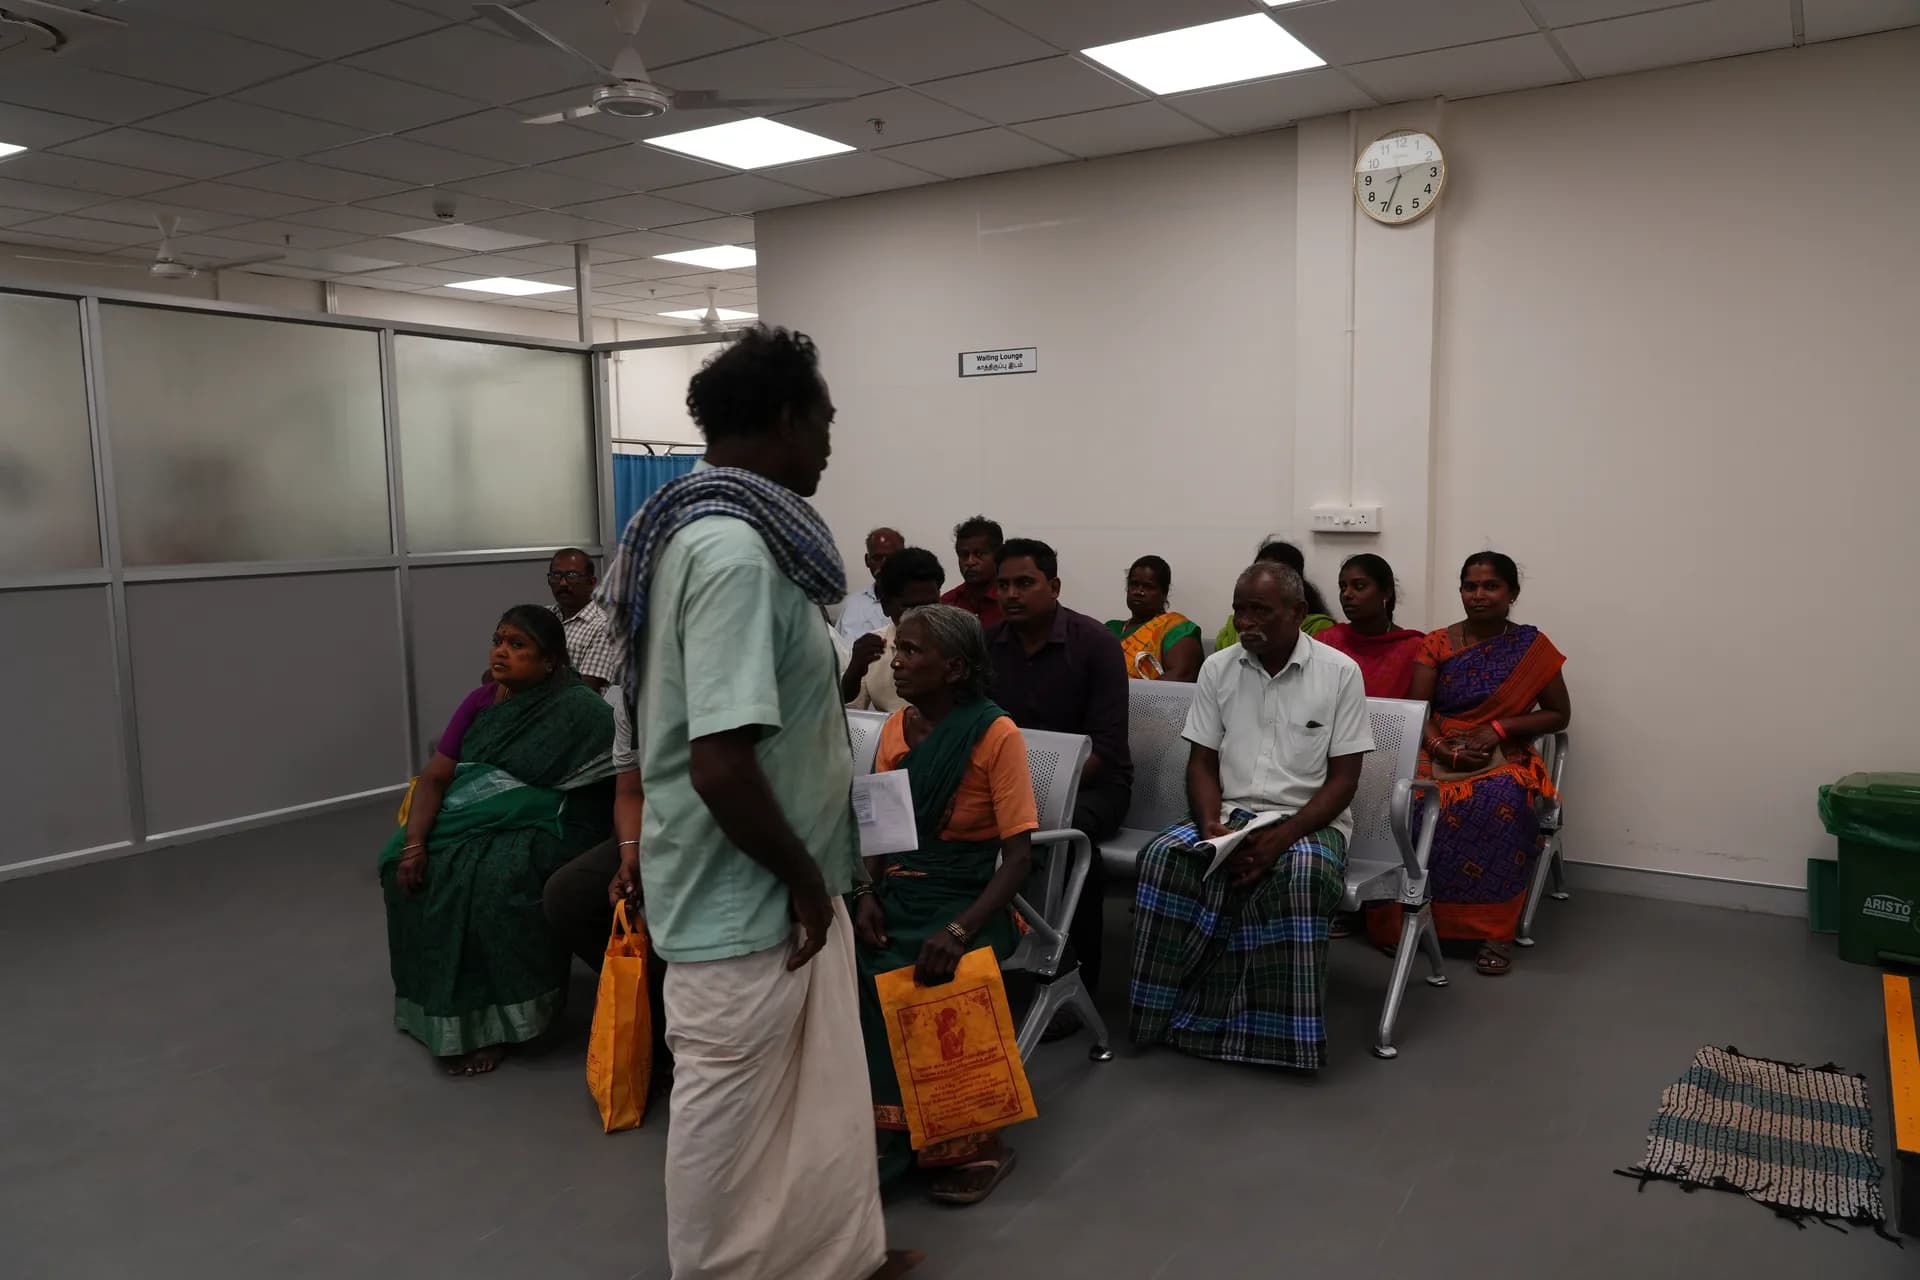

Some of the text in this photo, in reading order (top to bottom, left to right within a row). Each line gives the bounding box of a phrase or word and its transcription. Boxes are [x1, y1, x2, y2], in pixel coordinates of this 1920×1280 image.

[1395, 137, 1408, 148] 12
[1415, 139, 1420, 150] 1
[1381, 144, 1390, 155] 11
[1425, 151, 1433, 161] 2
[1368, 158, 1380, 169] 10
[1430, 167, 1438, 177] 3
[1364, 175, 1372, 186] 9
[1424, 183, 1432, 194] 4
[1368, 191, 1376, 202] 8
[1380, 201, 1388, 212] 7
[1412, 198, 1419, 209] 5
[1395, 205, 1403, 216] 6
[1863, 897, 1911, 916] ARISTO
